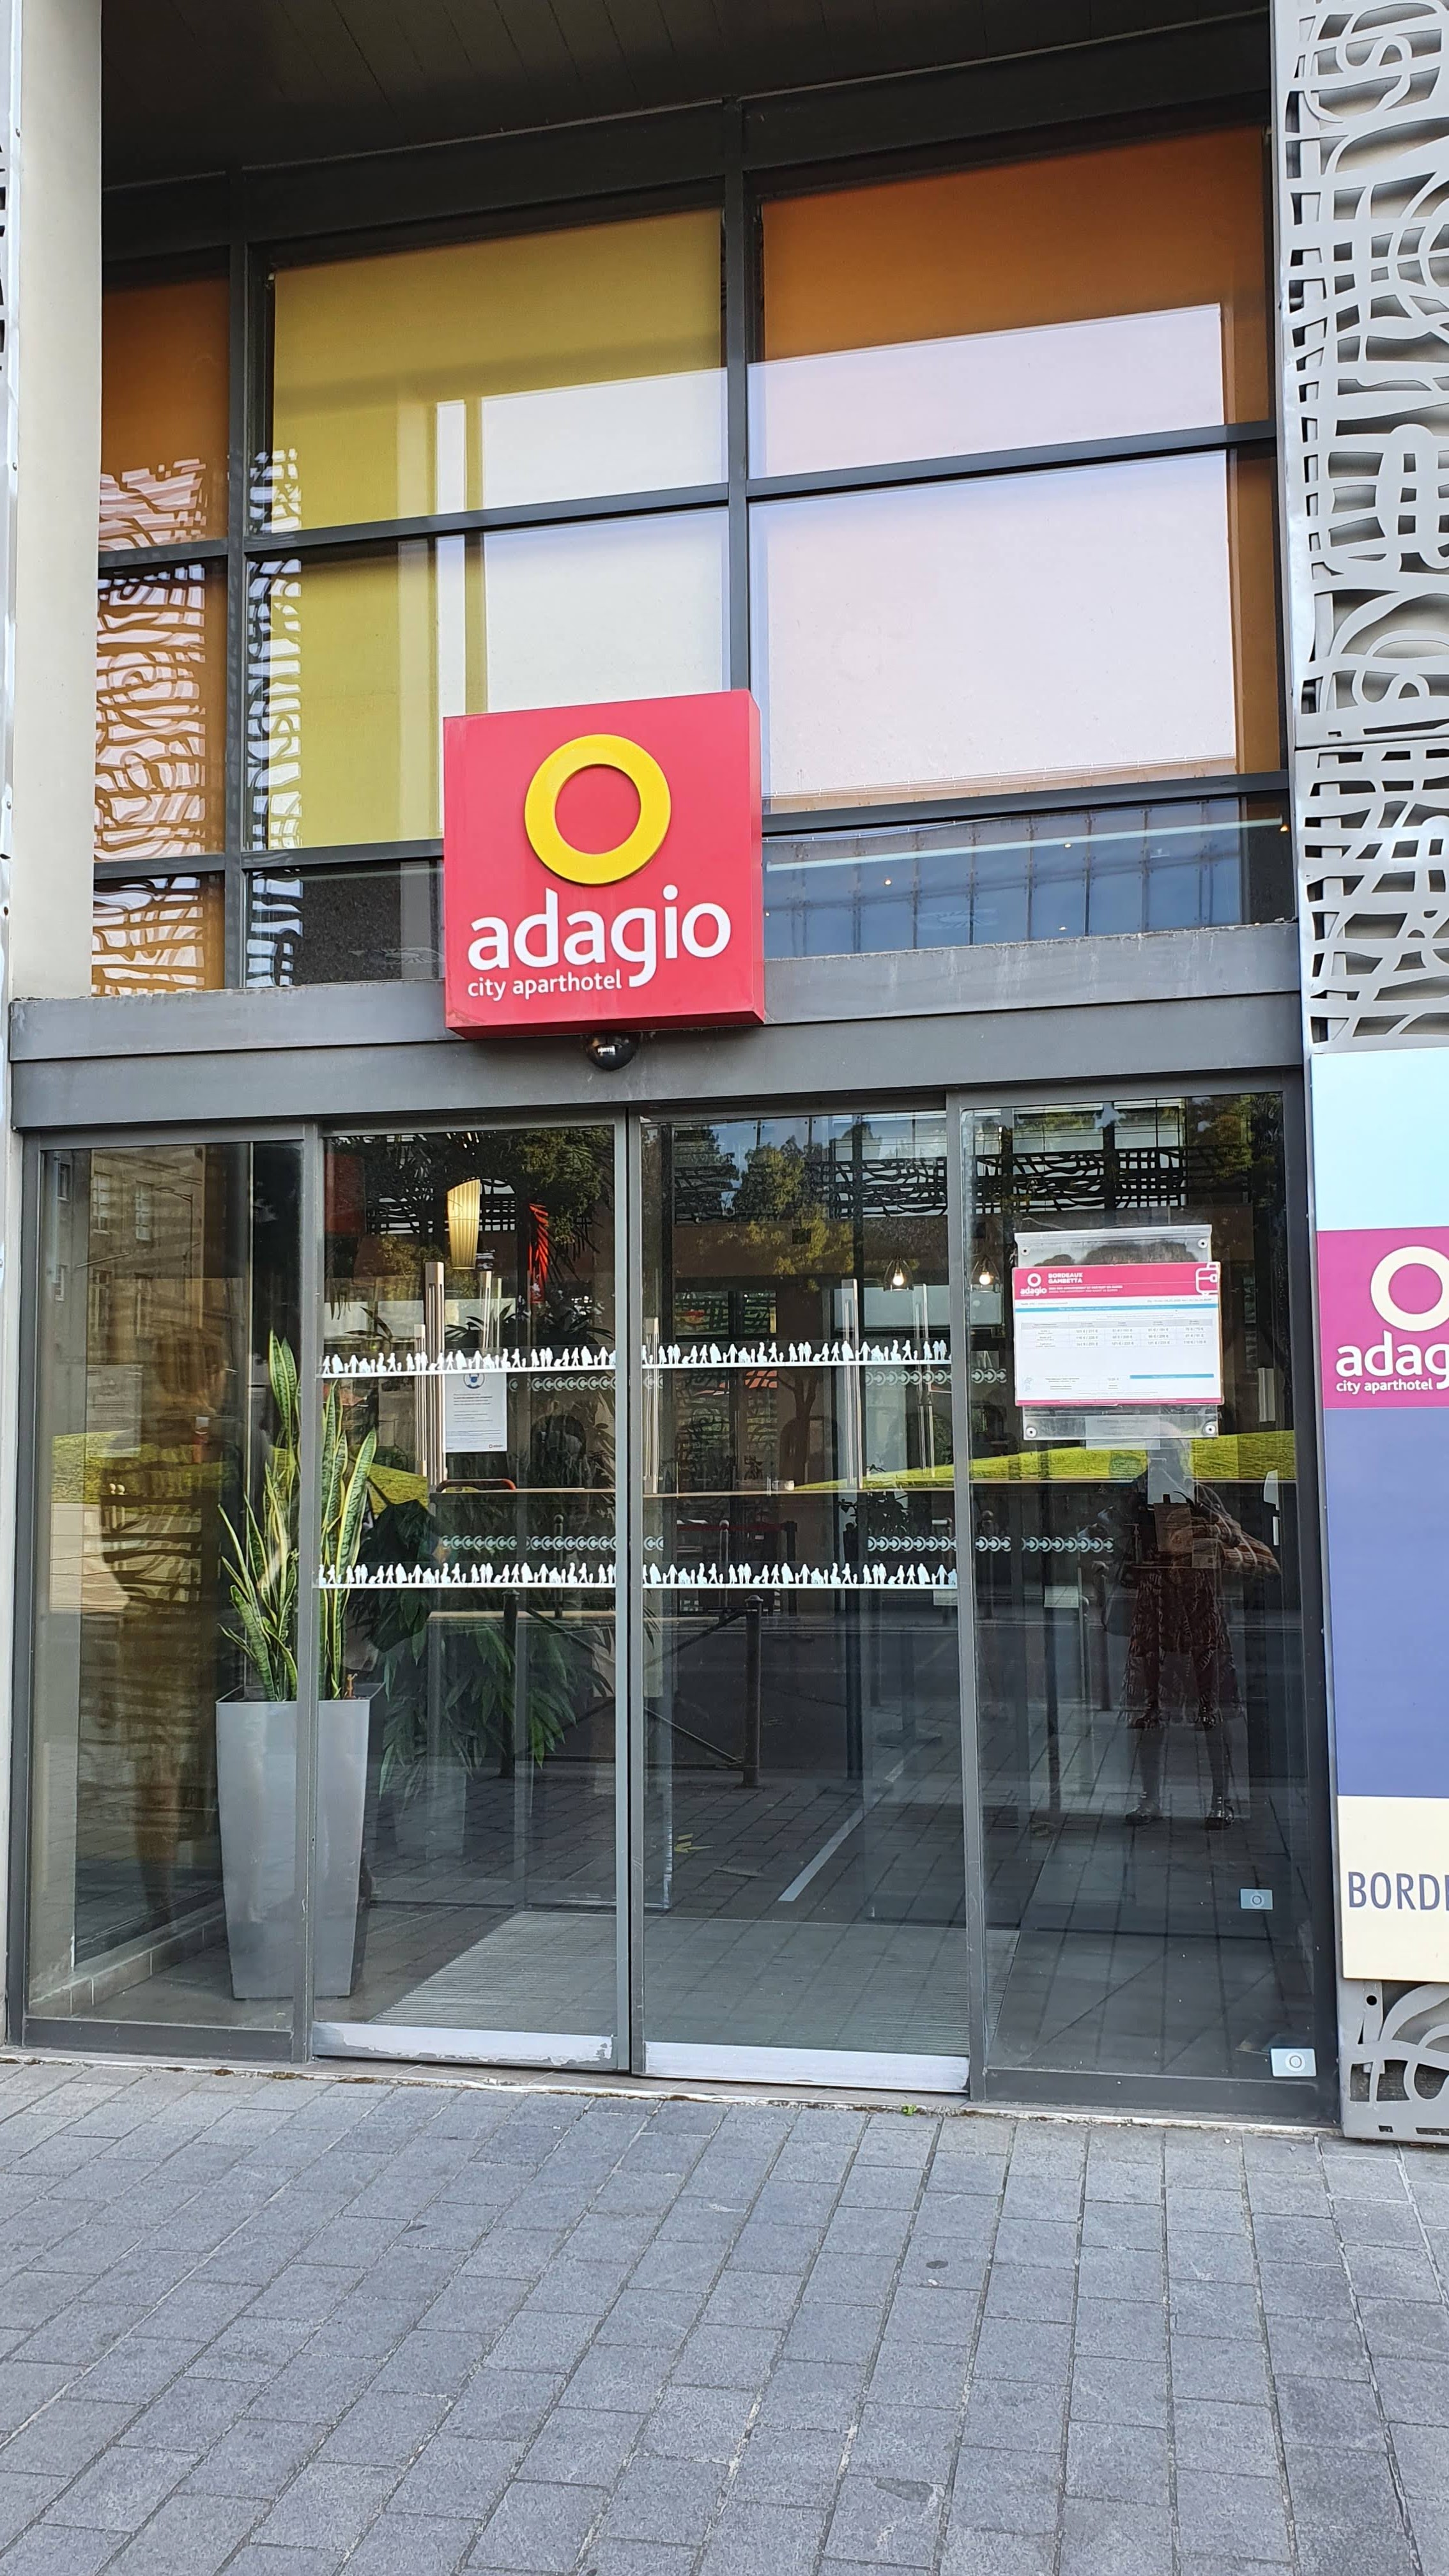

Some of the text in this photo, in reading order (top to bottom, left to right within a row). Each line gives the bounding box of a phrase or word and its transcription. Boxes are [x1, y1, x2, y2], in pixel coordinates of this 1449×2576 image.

[468, 884, 731, 988] adagio
[468, 969, 622, 1001] city aparthotel
[1020, 1285, 1048, 1296] adagio
[1336, 1378, 1433, 1395] city aparthotel
